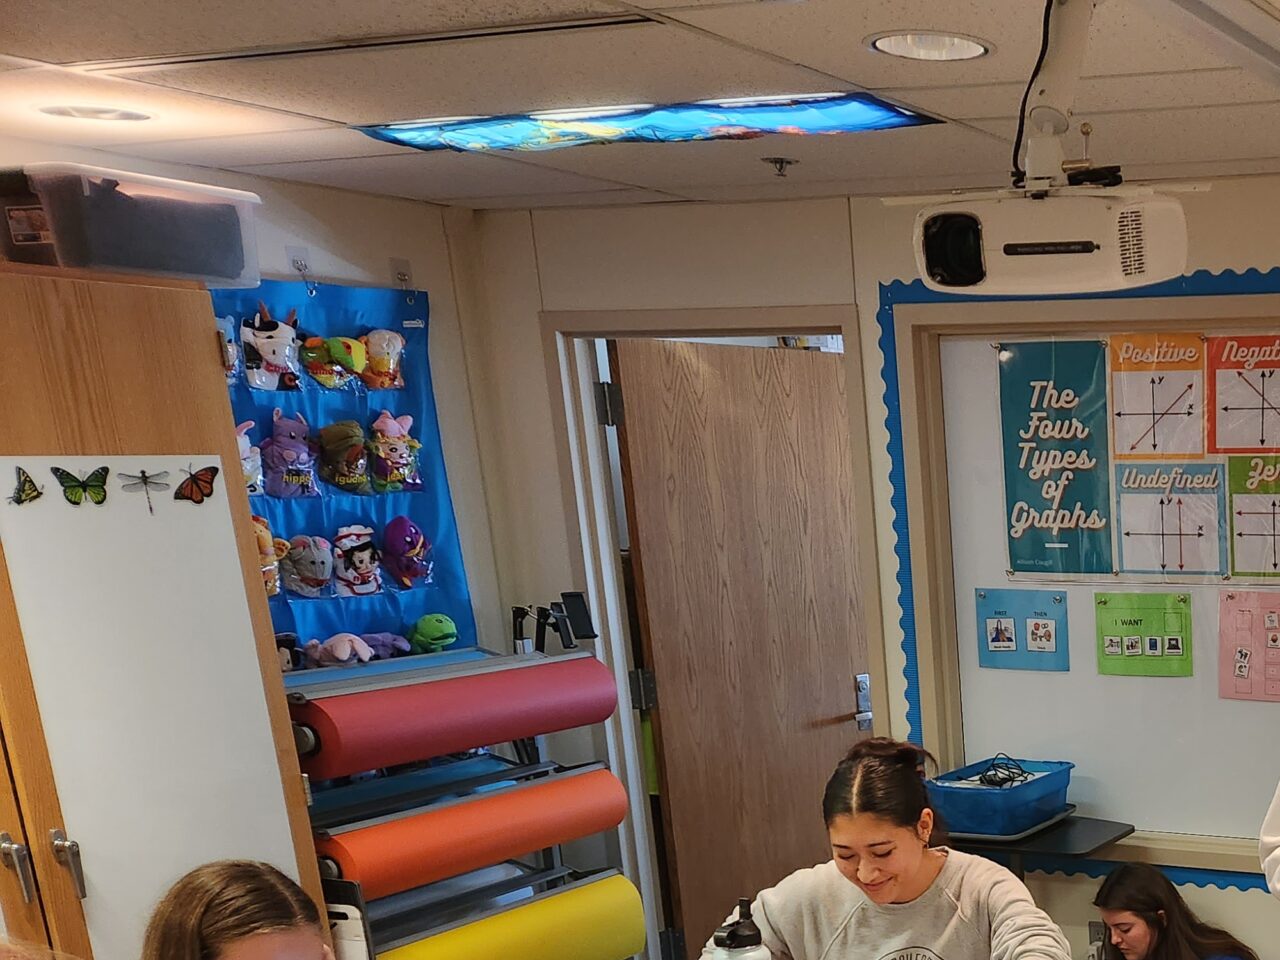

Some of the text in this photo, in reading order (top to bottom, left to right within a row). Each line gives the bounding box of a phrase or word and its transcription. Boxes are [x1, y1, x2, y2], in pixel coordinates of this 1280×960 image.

[1119, 342, 1198, 363] Positive
[1029, 381, 1080, 409] The
[1019, 412, 1089, 439] Four
[1018, 442, 1096, 478] Types
[1042, 471, 1072, 509] of
[1121, 467, 1220, 495] Undefined
[1010, 502, 1106, 538] Graphs
